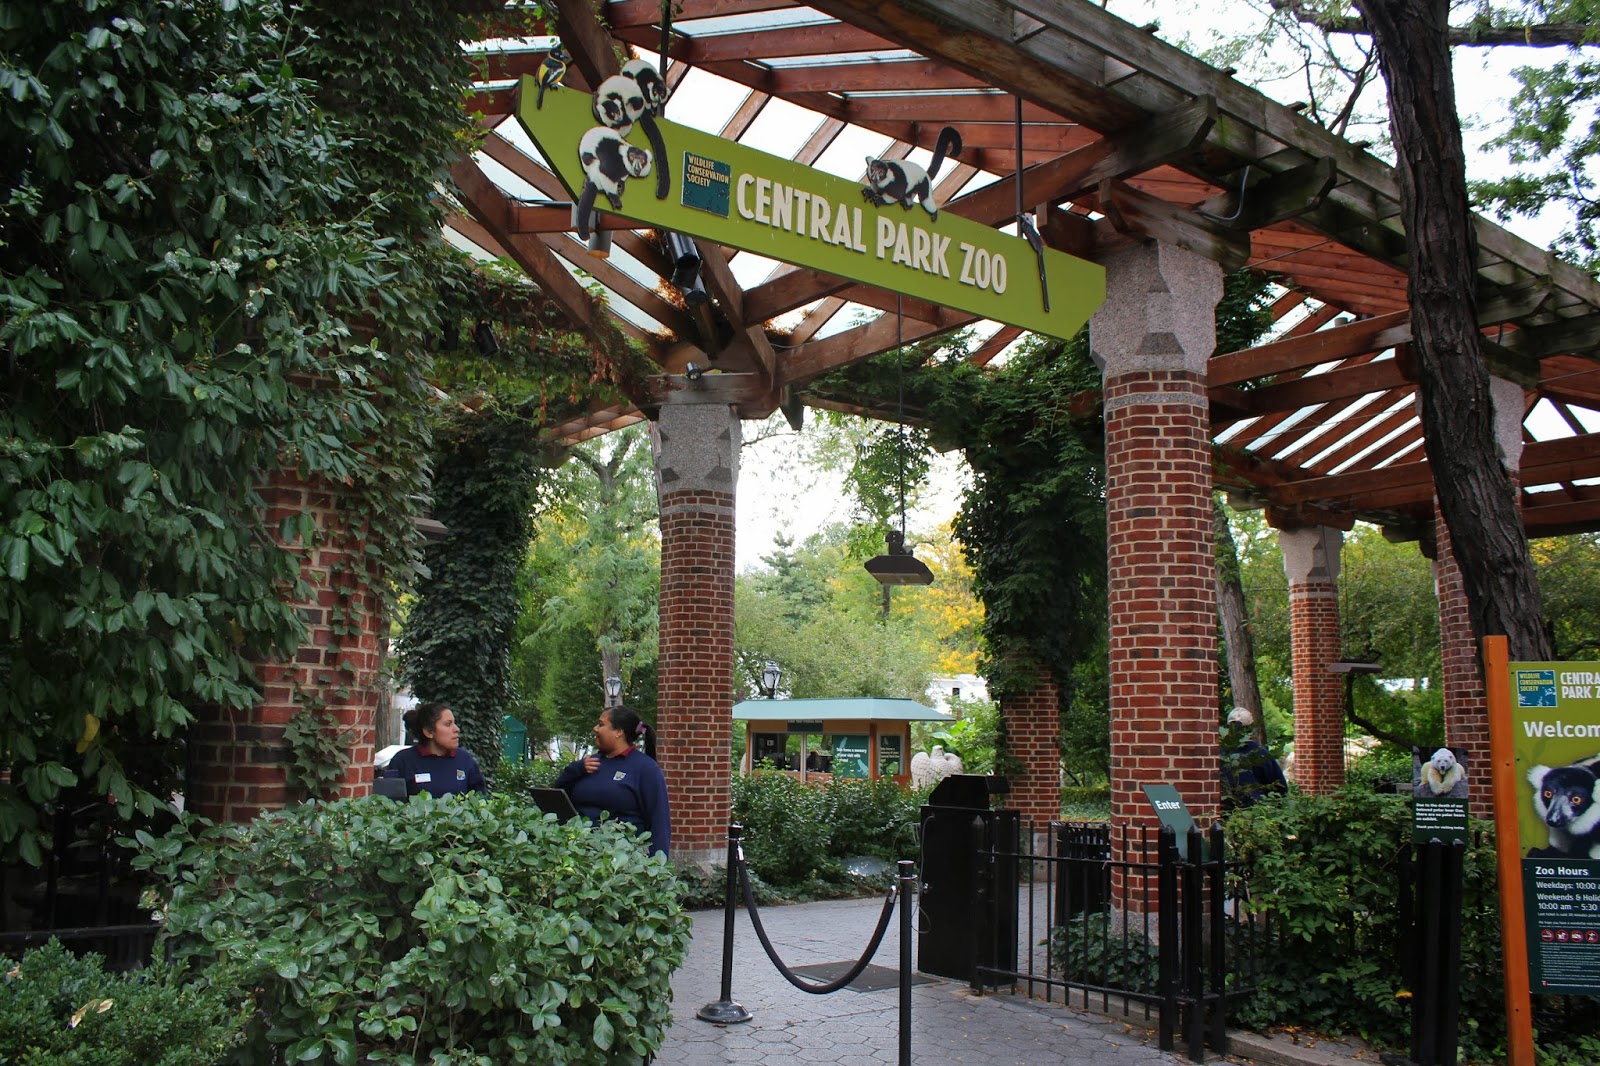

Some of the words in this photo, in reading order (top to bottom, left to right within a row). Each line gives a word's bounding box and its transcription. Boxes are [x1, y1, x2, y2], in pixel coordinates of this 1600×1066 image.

[688, 155, 714, 170] WILDLIFE
[686, 173, 710, 187] SOCIETY
[688, 164, 729, 184] CONSERVATION
[737, 173, 866, 253] CENTRAL
[876, 216, 952, 278] PARK
[960, 242, 1008, 294] ZOO
[1562, 686, 1592, 698] PARK
[1154, 800, 1180, 810] Enter
[1535, 866, 1554, 875] Zoo
[1558, 866, 1589, 876] Hours
[1536, 882, 1574, 890] Weekdays:
